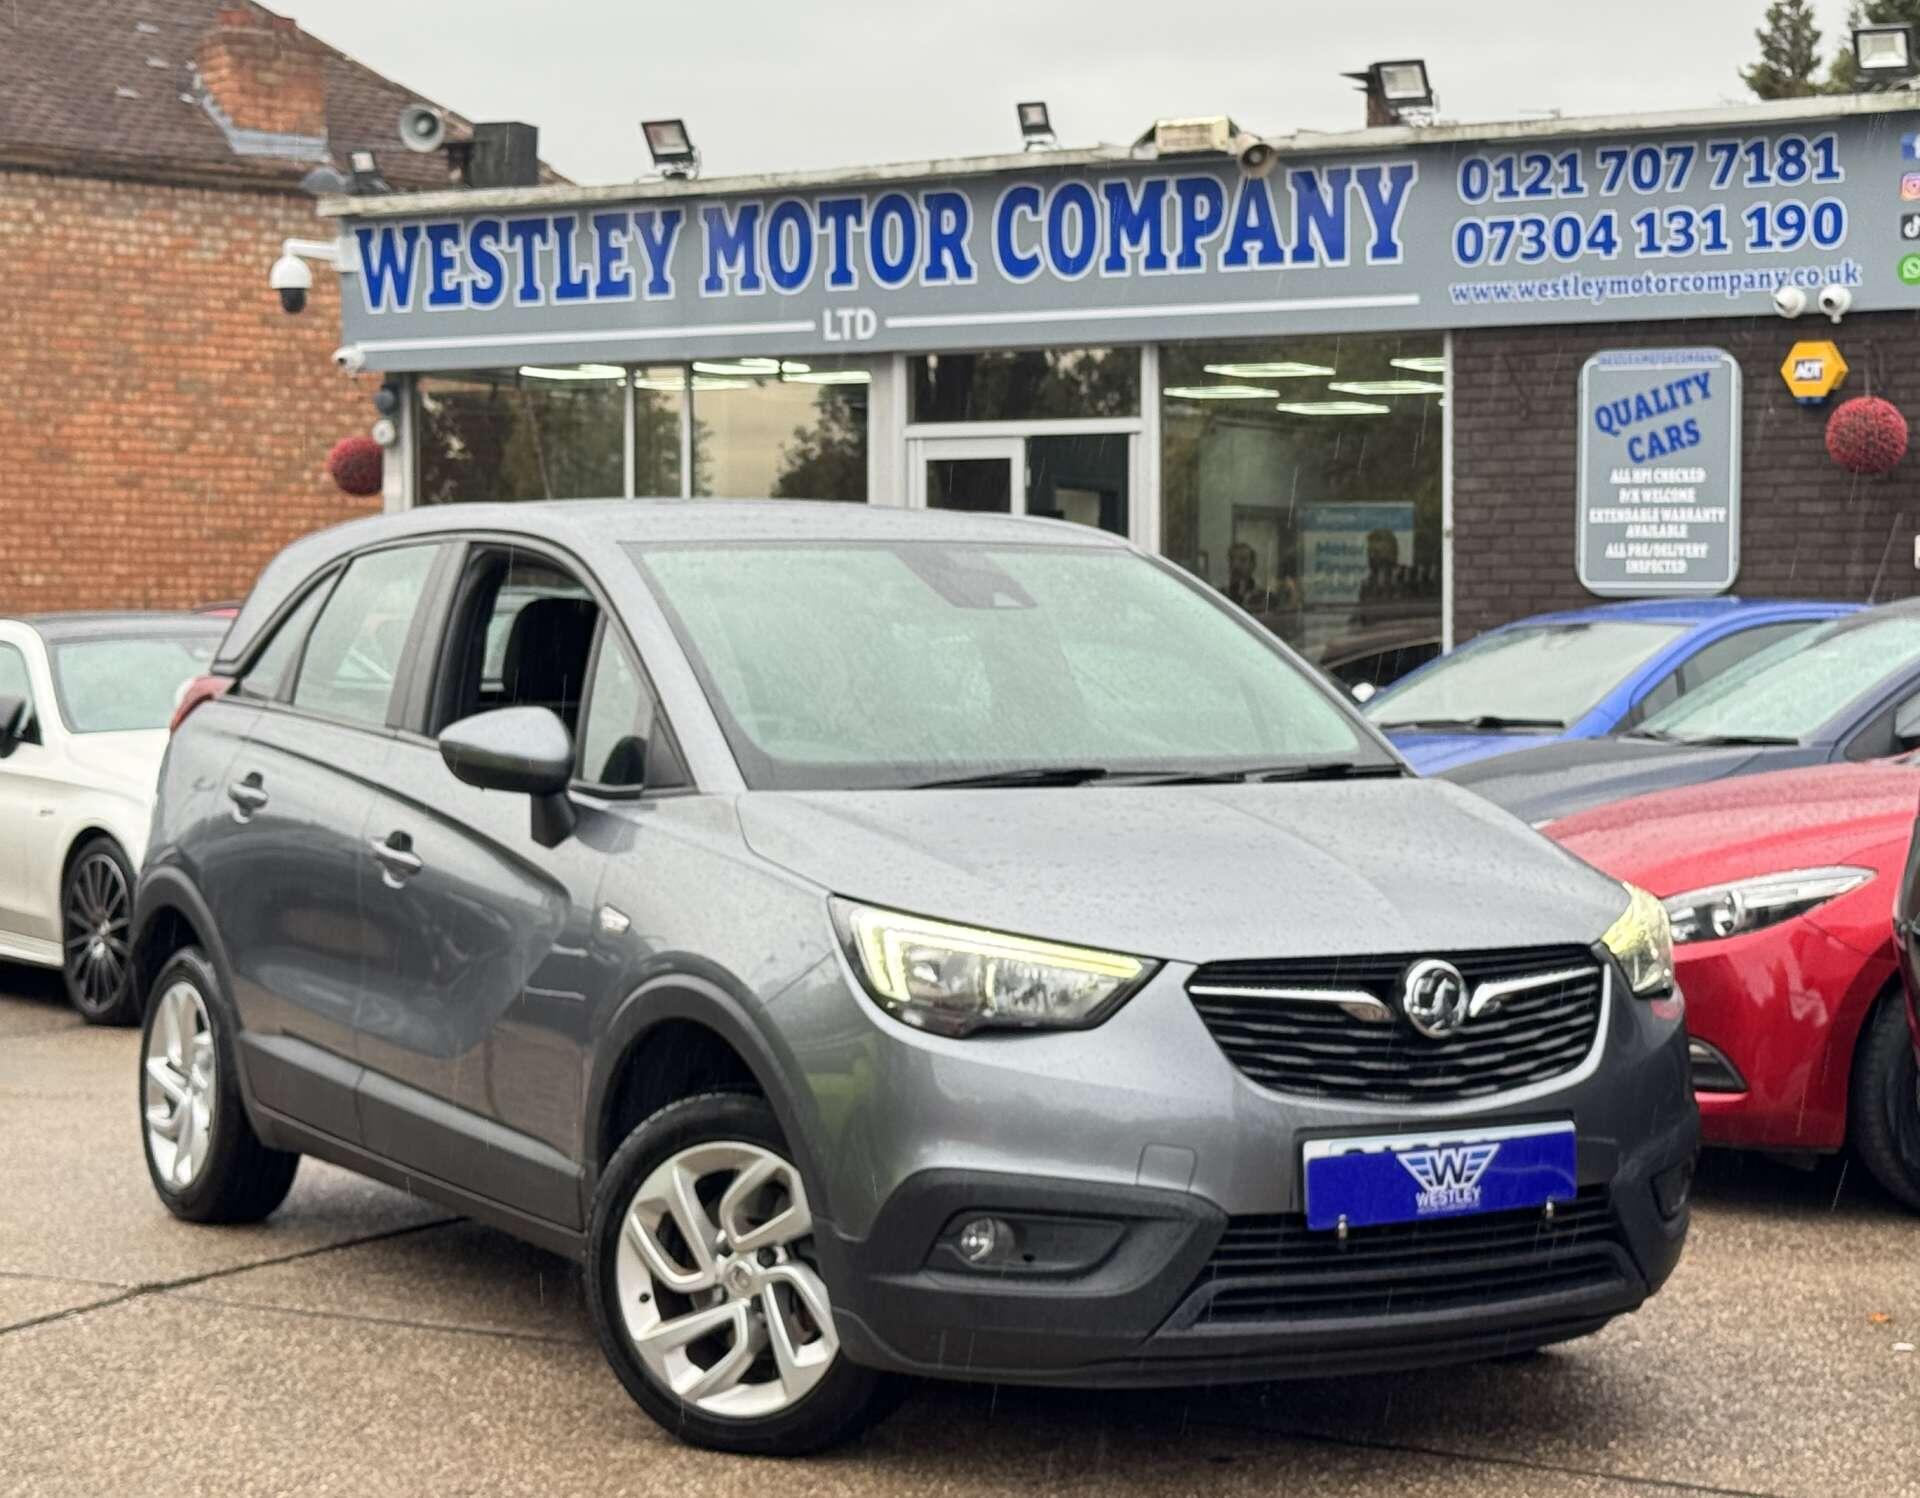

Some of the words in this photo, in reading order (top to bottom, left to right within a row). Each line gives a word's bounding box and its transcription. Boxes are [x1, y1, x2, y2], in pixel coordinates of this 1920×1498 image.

[1461, 150, 1585, 202] 0121
[1600, 144, 1696, 192] 707
[1711, 134, 1842, 187] 7181
[354, 208, 685, 313] WESTLEY
[700, 190, 976, 296] MOTOR
[995, 162, 1417, 283] COMPANY
[1454, 212, 1617, 265] 07304
[1636, 206, 1730, 256] 131
[1746, 199, 1848, 251] 190
[1450, 259, 1862, 303] www.westleymotorcompany.co.uk
[823, 308, 877, 341] LTD
[1594, 371, 1712, 437] QUALITY
[1627, 417, 1701, 464] CARS
[1609, 468, 1631, 484] ALL
[1653, 467, 1706, 483] CHECKED
[1641, 488, 1696, 503] WELCOME
[1625, 524, 1688, 538] AVAILABLE
[1660, 507, 1727, 522] WARRANTY
[1605, 543, 1626, 558] ALL
[1415, 1185, 1481, 1208] WESTLEY
